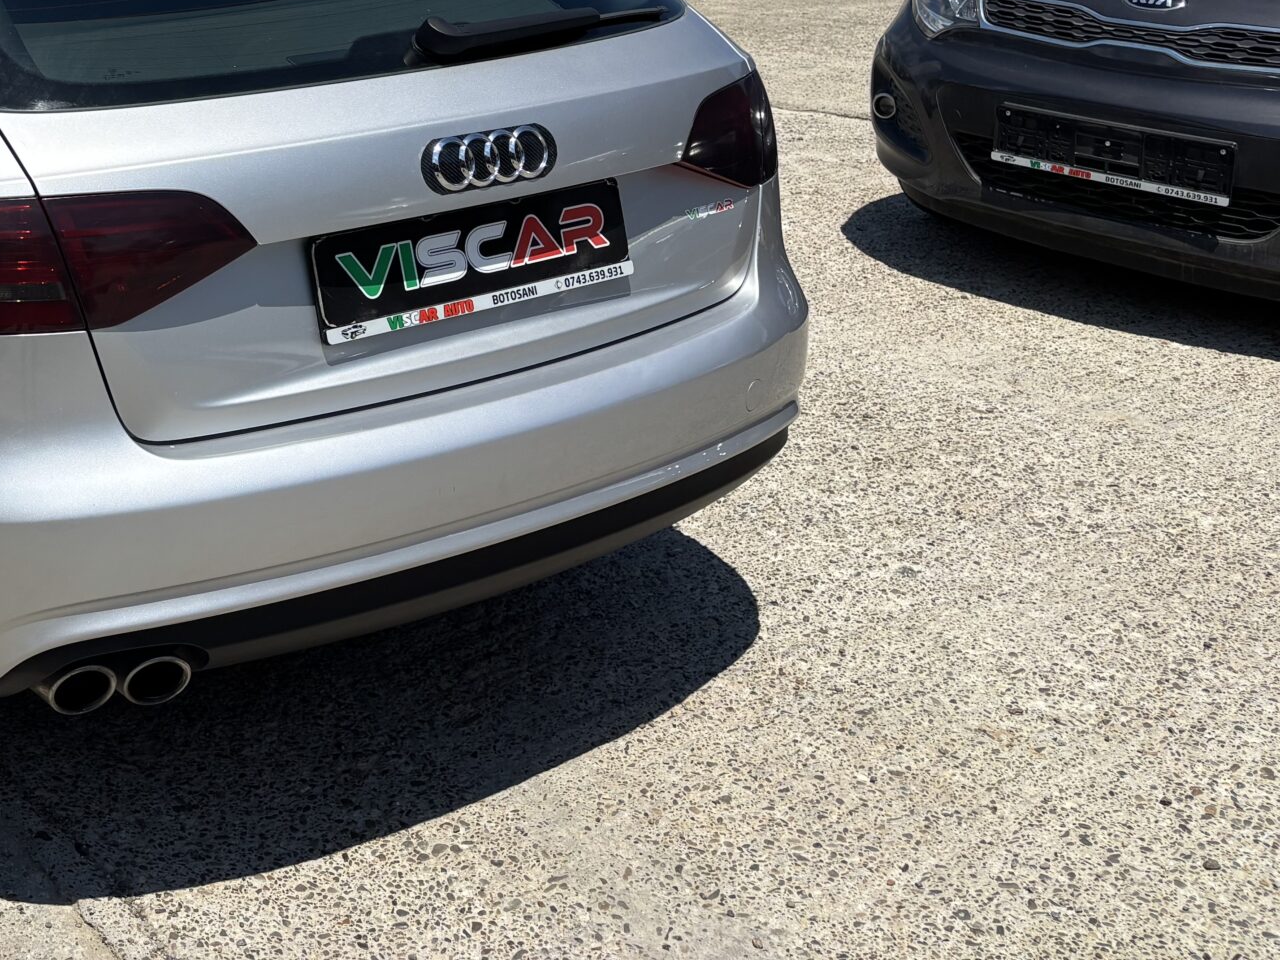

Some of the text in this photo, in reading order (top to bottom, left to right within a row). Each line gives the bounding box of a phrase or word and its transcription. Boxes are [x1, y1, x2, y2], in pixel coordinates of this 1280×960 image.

[1104, 176, 1142, 189] BOTOSANI
[1164, 187, 1218, 204] 0743.639.931
[335, 203, 610, 299] VISCAR
[387, 265, 624, 331] VISCAR AUTO BOTOSANI 0743.639.931
